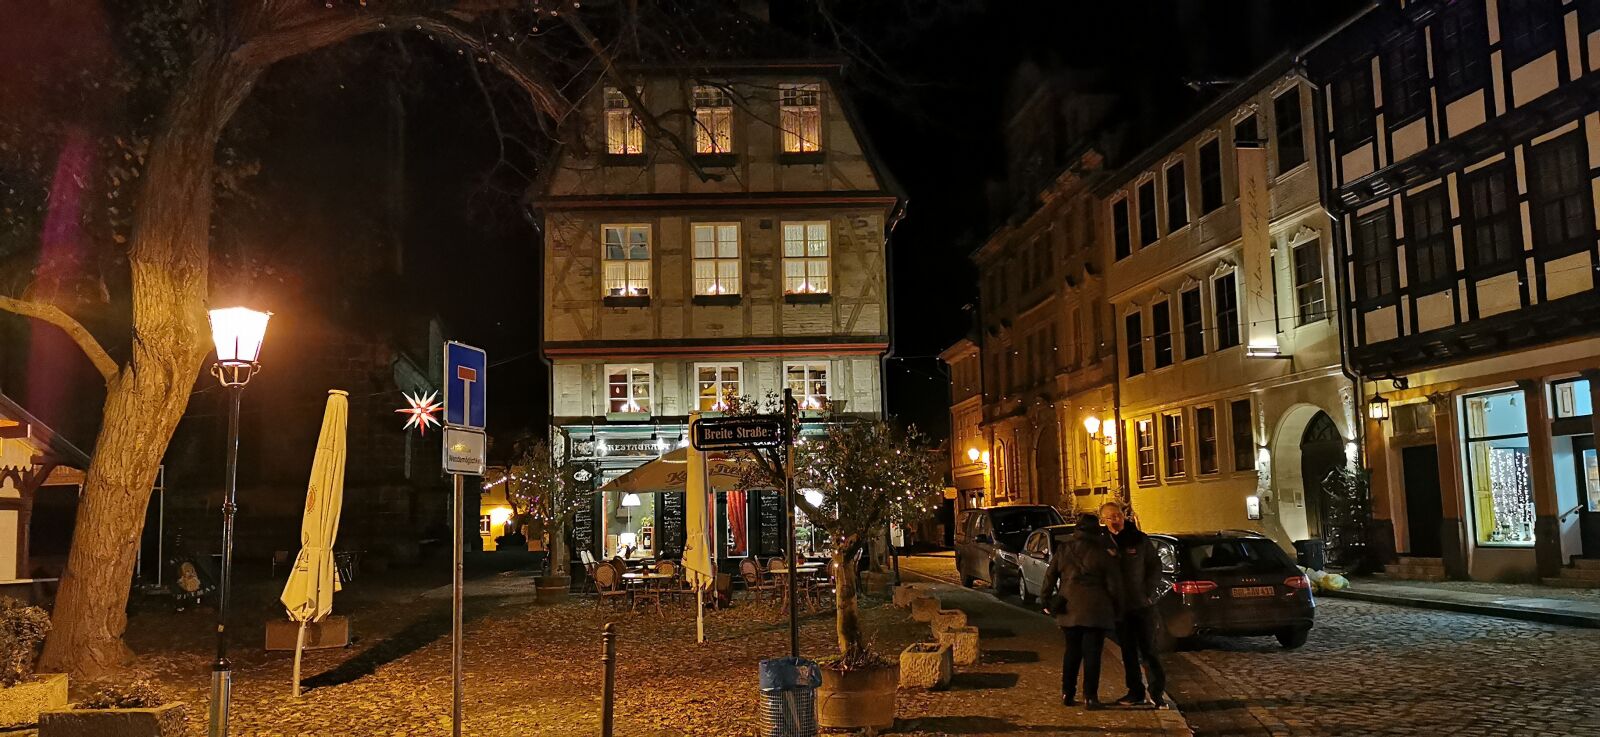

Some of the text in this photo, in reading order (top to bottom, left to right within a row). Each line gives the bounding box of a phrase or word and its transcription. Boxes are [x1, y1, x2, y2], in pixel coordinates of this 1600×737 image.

[704, 426, 768, 440] Breite Straße
[607, 442, 671, 452] RESTAURAT
